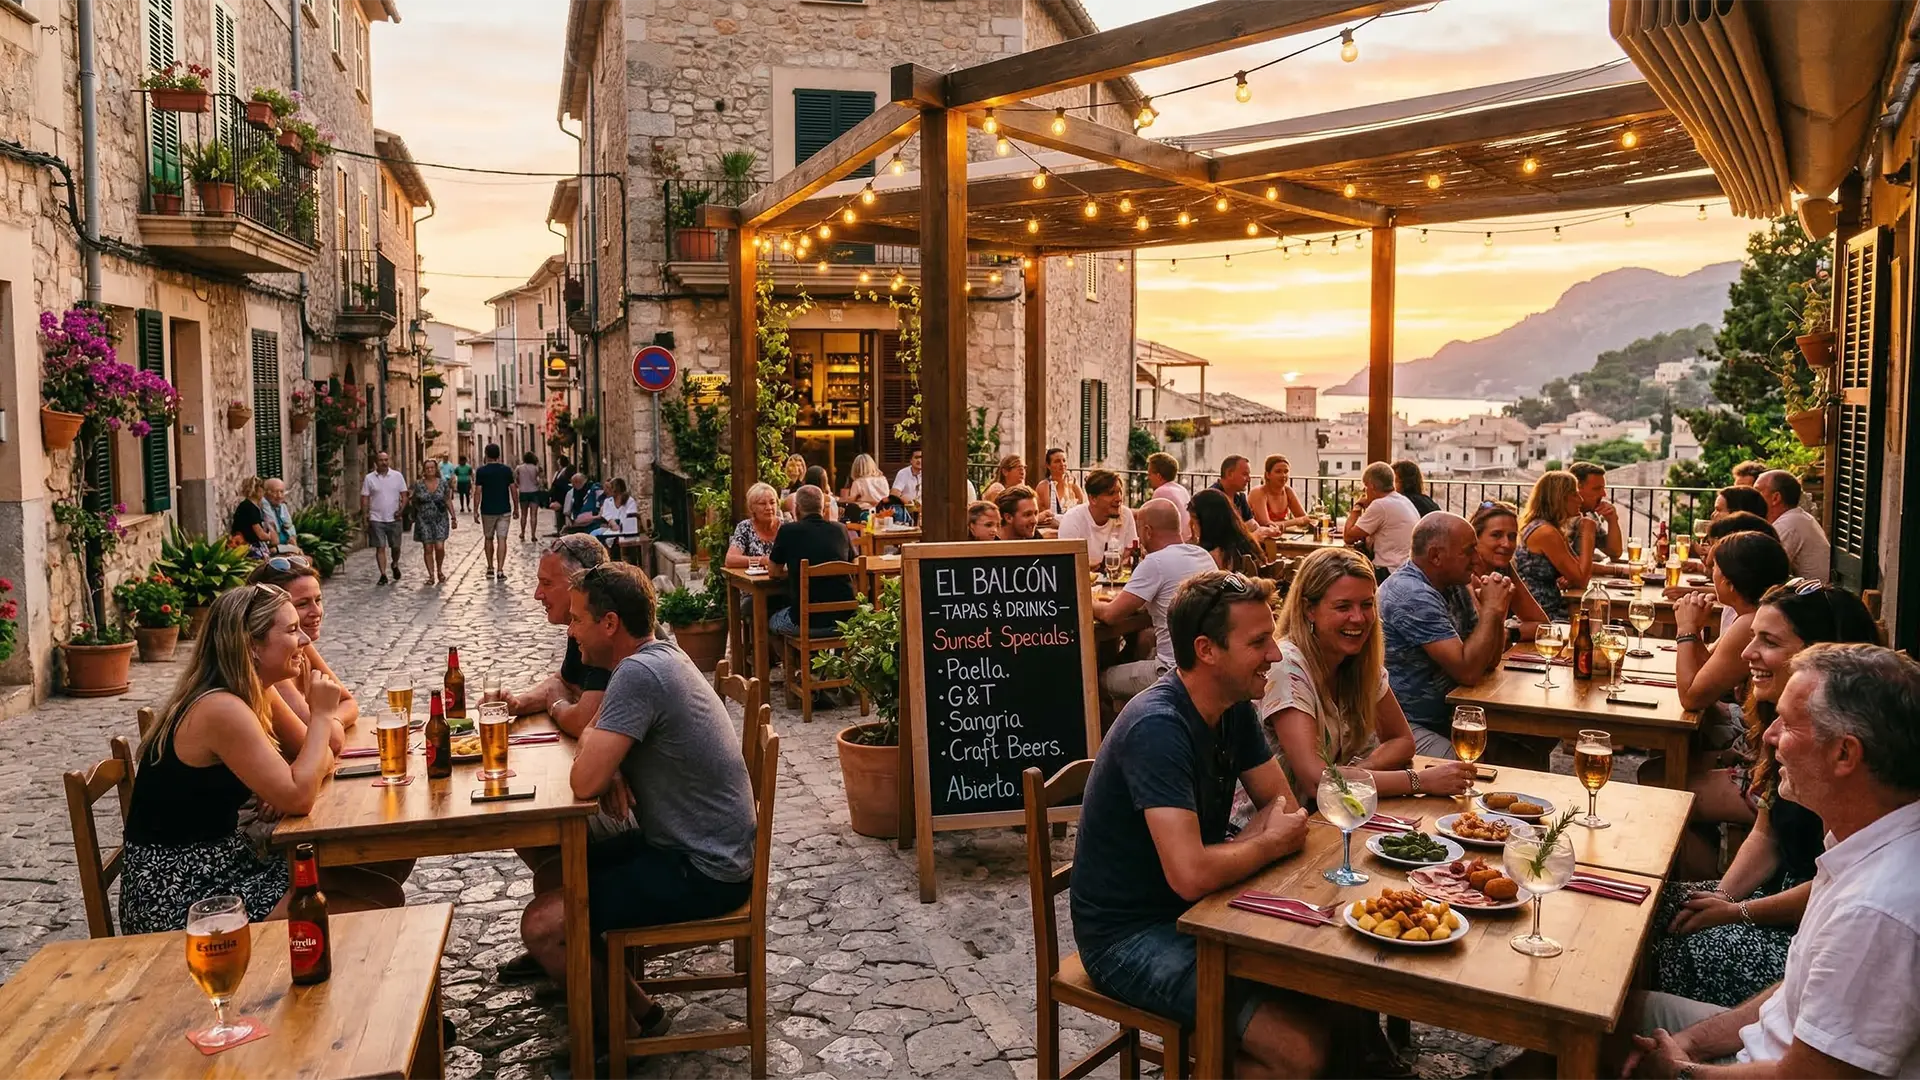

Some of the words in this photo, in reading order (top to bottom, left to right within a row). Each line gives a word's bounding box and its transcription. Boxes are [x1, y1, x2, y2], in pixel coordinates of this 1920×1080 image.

[936, 568, 965, 596] EL
[972, 558, 1057, 595] BALCÓN
[932, 626, 993, 651] Sunset
[947, 683, 996, 707] G&T
[949, 710, 1024, 738] Sangria
[949, 737, 1000, 768] Craft
[196, 939, 238, 952] Estrella
